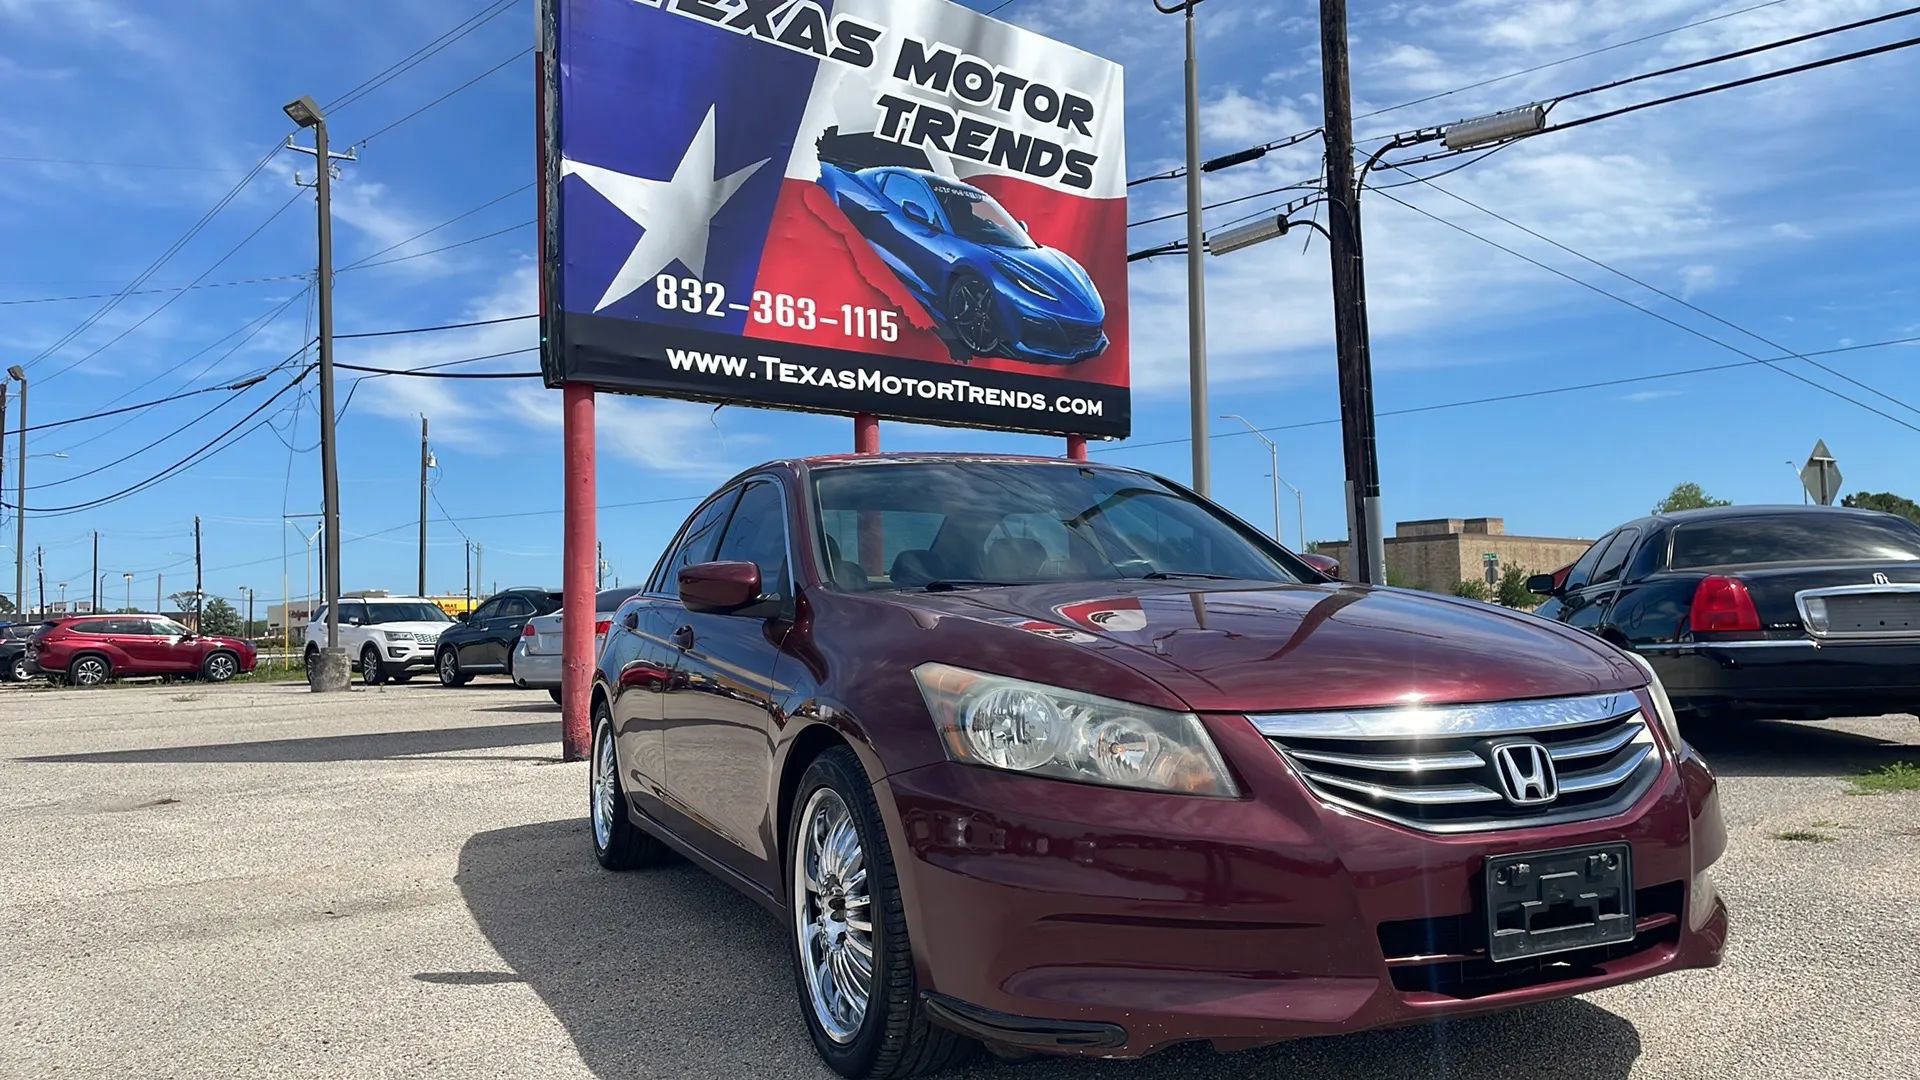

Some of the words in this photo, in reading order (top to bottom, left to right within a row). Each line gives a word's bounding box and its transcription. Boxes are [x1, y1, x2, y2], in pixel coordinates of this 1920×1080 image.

[635, 0, 883, 68] XAS
[892, 37, 1095, 138] MOTOR
[876, 94, 1099, 190] TRENDS
[655, 273, 899, 343] 832-363-1115
